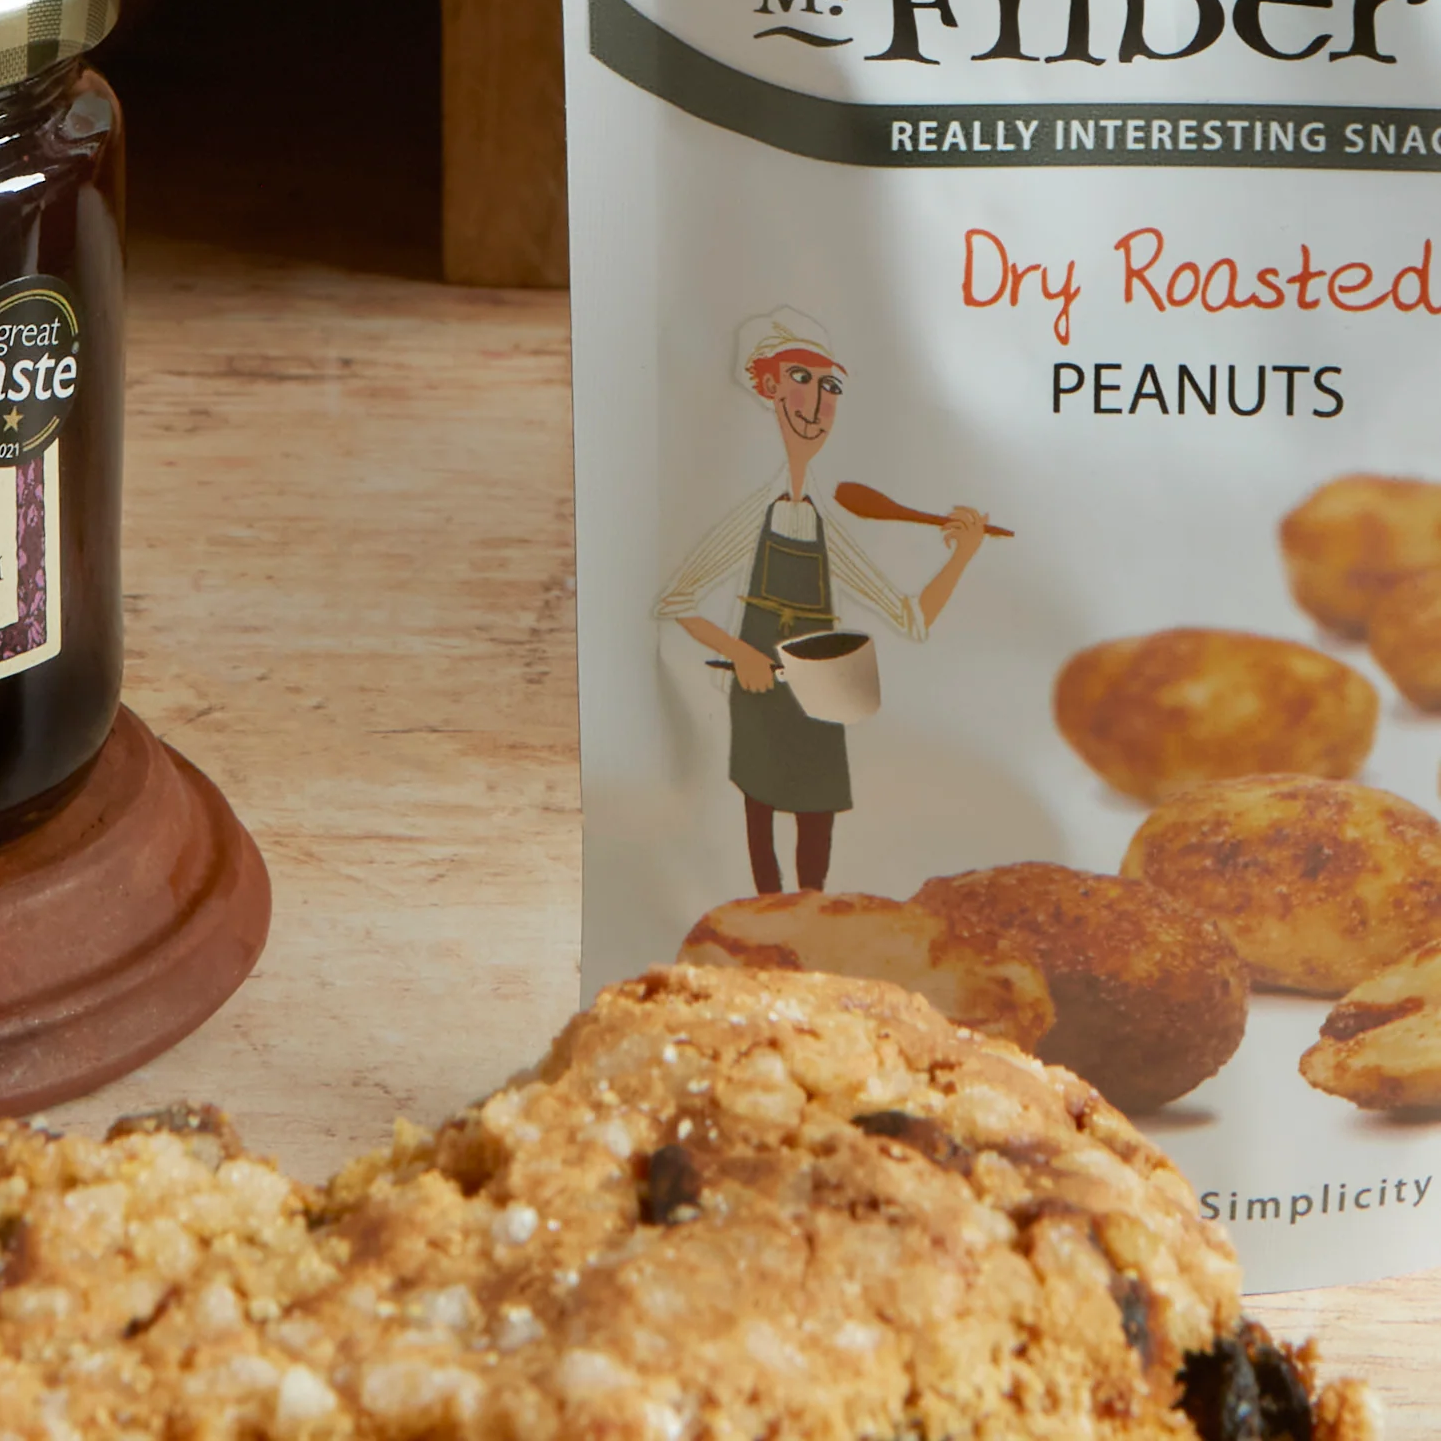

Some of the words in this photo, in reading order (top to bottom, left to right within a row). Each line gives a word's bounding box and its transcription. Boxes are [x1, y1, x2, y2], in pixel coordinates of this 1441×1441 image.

[891, 120, 1040, 152] REALLY
[1056, 120, 1327, 153] INTERESTING
[961, 227, 1080, 346] Dry
[1114, 226, 1441, 315] Roasted
[1052, 362, 1345, 418] PEANUTS
[1199, 1174, 1433, 1225] Simplicity
